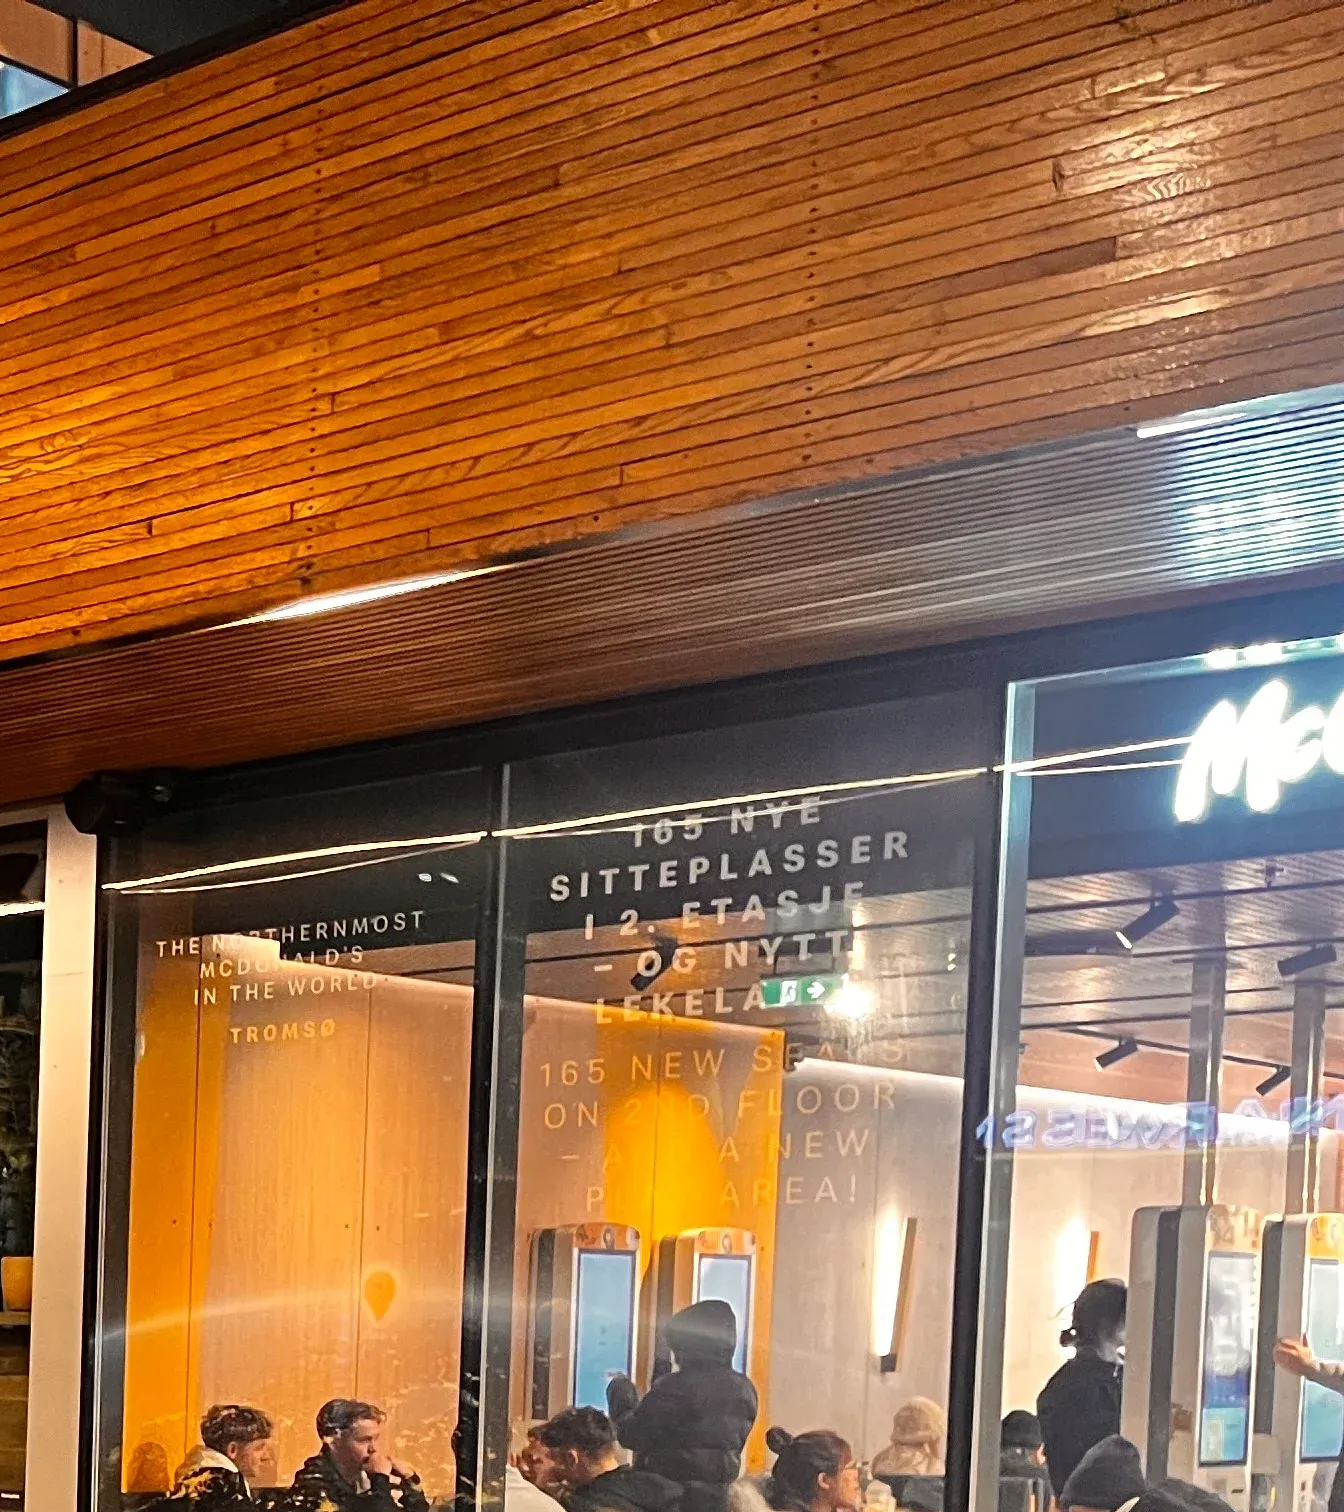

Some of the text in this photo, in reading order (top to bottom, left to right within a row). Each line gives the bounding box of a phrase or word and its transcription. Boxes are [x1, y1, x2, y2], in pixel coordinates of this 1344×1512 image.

[1174, 679, 1344, 822] Mc
[633, 797, 821, 848] 165 NYE
[550, 831, 909, 902] SITTEPLASSER
[619, 909, 656, 937] 2.
[682, 881, 865, 930] ETASJE
[155, 936, 200, 958] THE
[200, 944, 364, 979] MCDOALD'S
[637, 947, 698, 977] OG
[724, 929, 850, 969] NYTT
[194, 971, 377, 1006] IN THE WORLD
[229, 1018, 337, 1045] TROMSØ
[539, 1057, 606, 1088] 165
[631, 1048, 725, 1081] NEW
[543, 1100, 599, 1130] ON
[737, 1081, 897, 1119] FLOOR
[767, 1128, 870, 1163] NEW
[720, 1174, 858, 1208] AREA!
